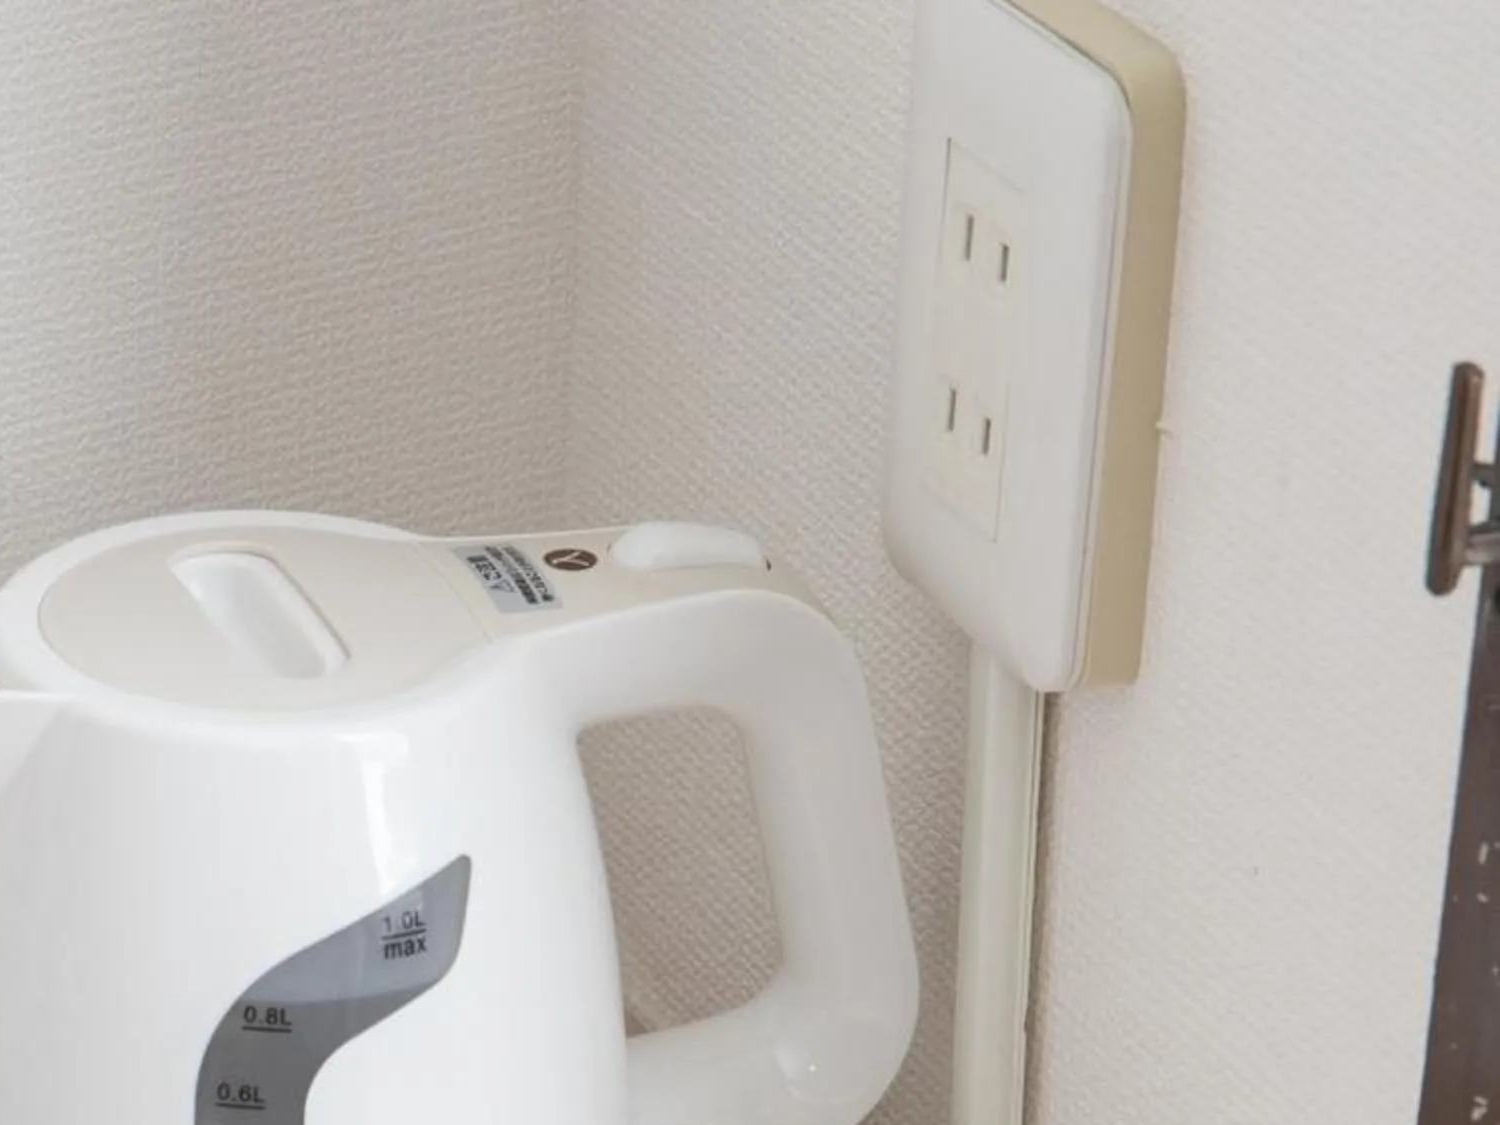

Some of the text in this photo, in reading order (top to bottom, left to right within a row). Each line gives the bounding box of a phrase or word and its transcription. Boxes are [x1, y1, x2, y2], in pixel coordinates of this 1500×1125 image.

[382, 910, 427, 931] 1.0L
[384, 937, 428, 960] max
[243, 1005, 292, 1027] 0.8L
[216, 1081, 265, 1104] 0.6L
